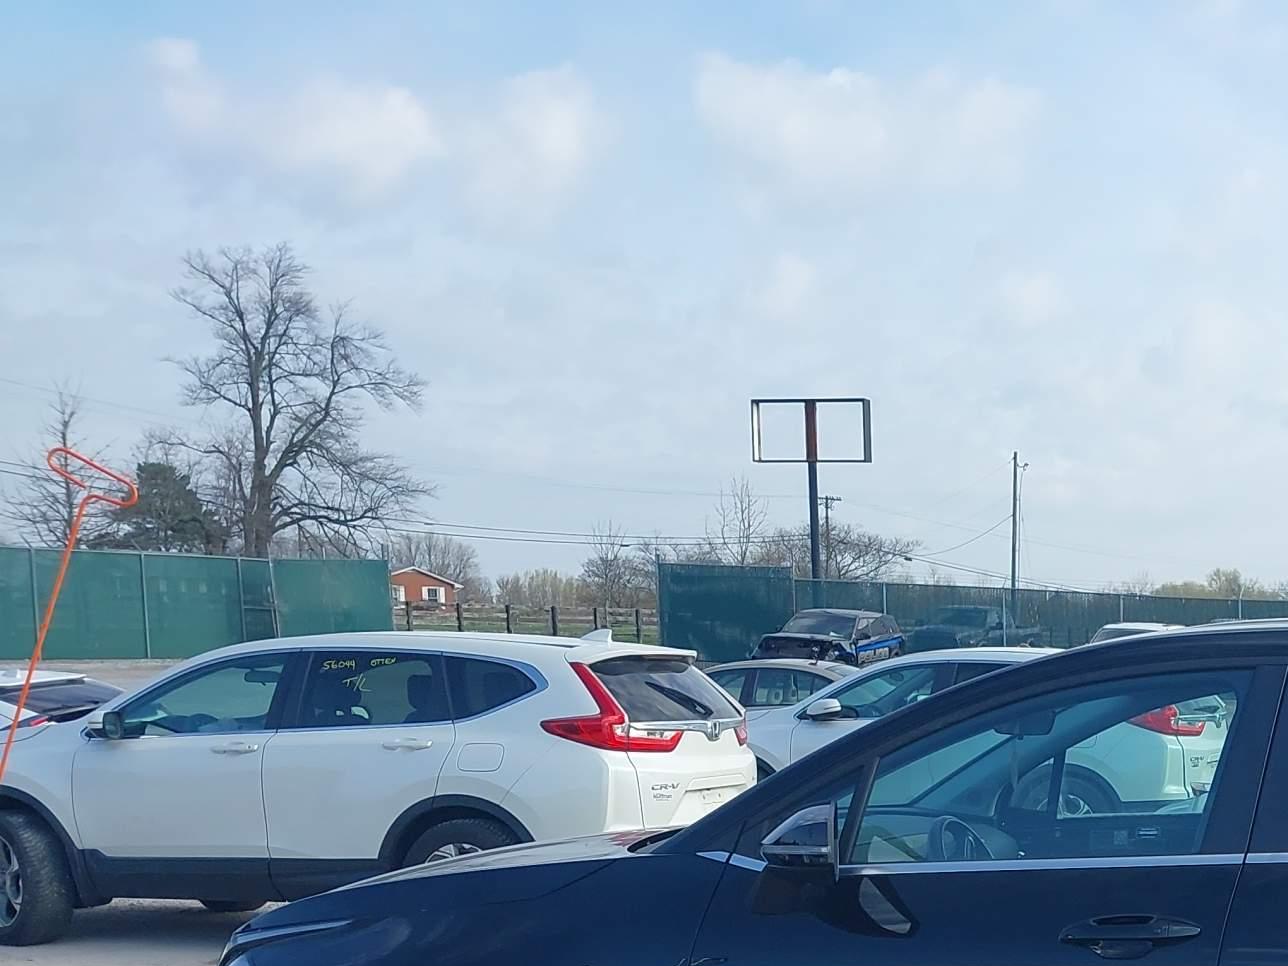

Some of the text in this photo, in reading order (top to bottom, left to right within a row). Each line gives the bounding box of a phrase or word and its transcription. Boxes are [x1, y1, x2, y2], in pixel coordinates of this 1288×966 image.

[322, 659, 356, 671] 56044
[342, 673, 372, 692] T/L
[651, 783, 681, 791] CR-V
